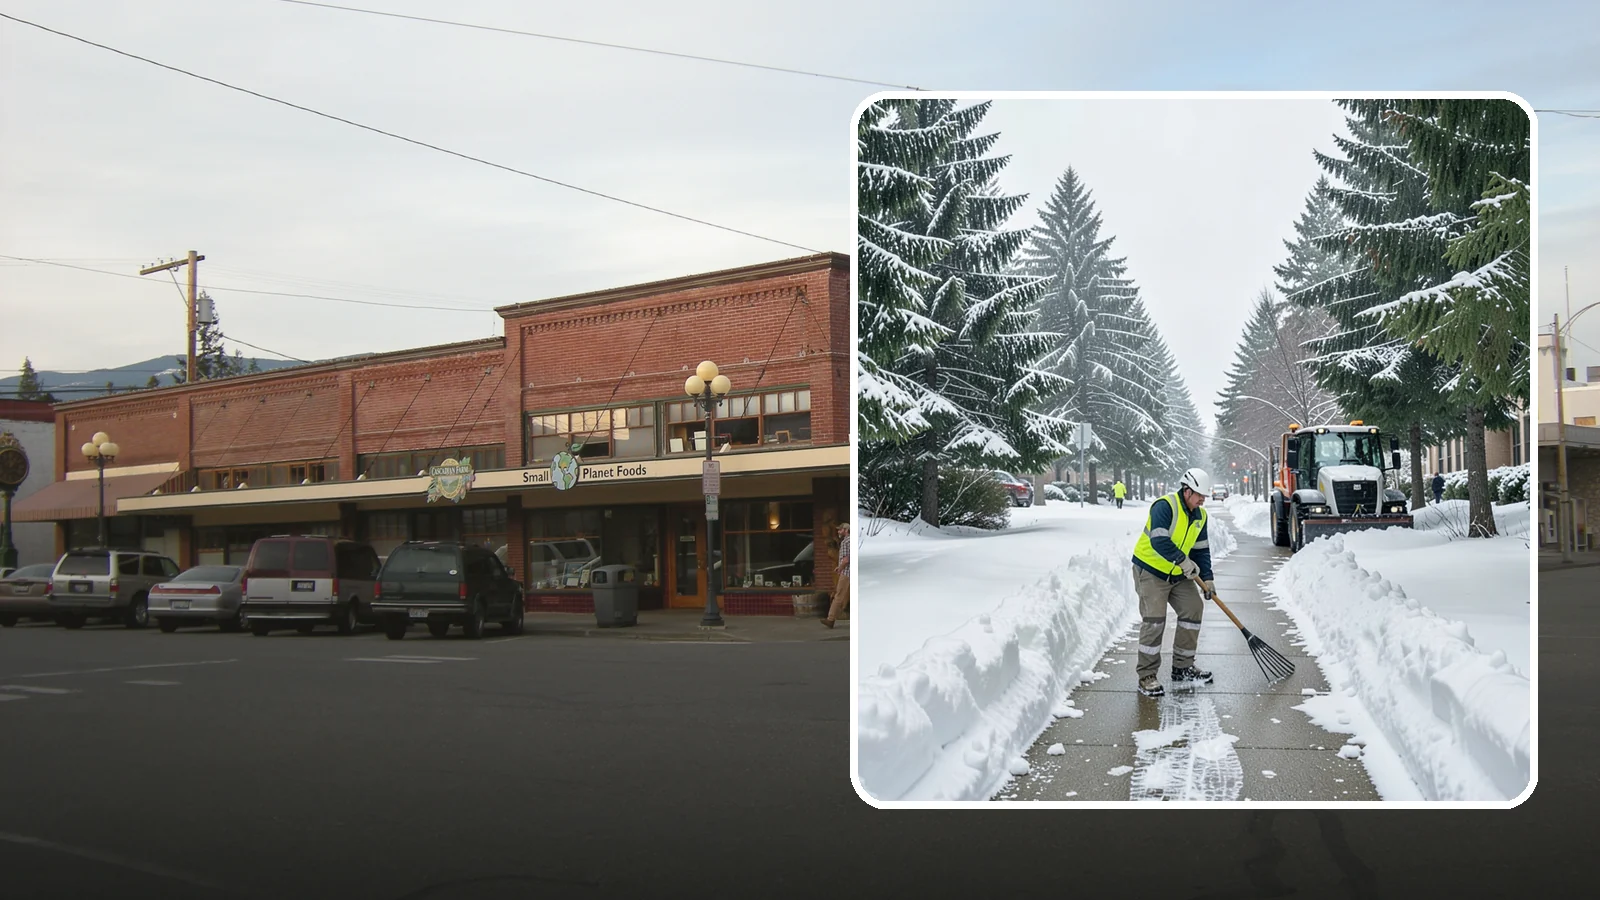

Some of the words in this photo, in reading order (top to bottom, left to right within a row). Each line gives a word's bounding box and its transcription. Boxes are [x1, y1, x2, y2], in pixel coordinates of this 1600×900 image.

[523, 471, 549, 483] Small
[583, 467, 614, 479] Planet
[616, 464, 647, 477] Foods
